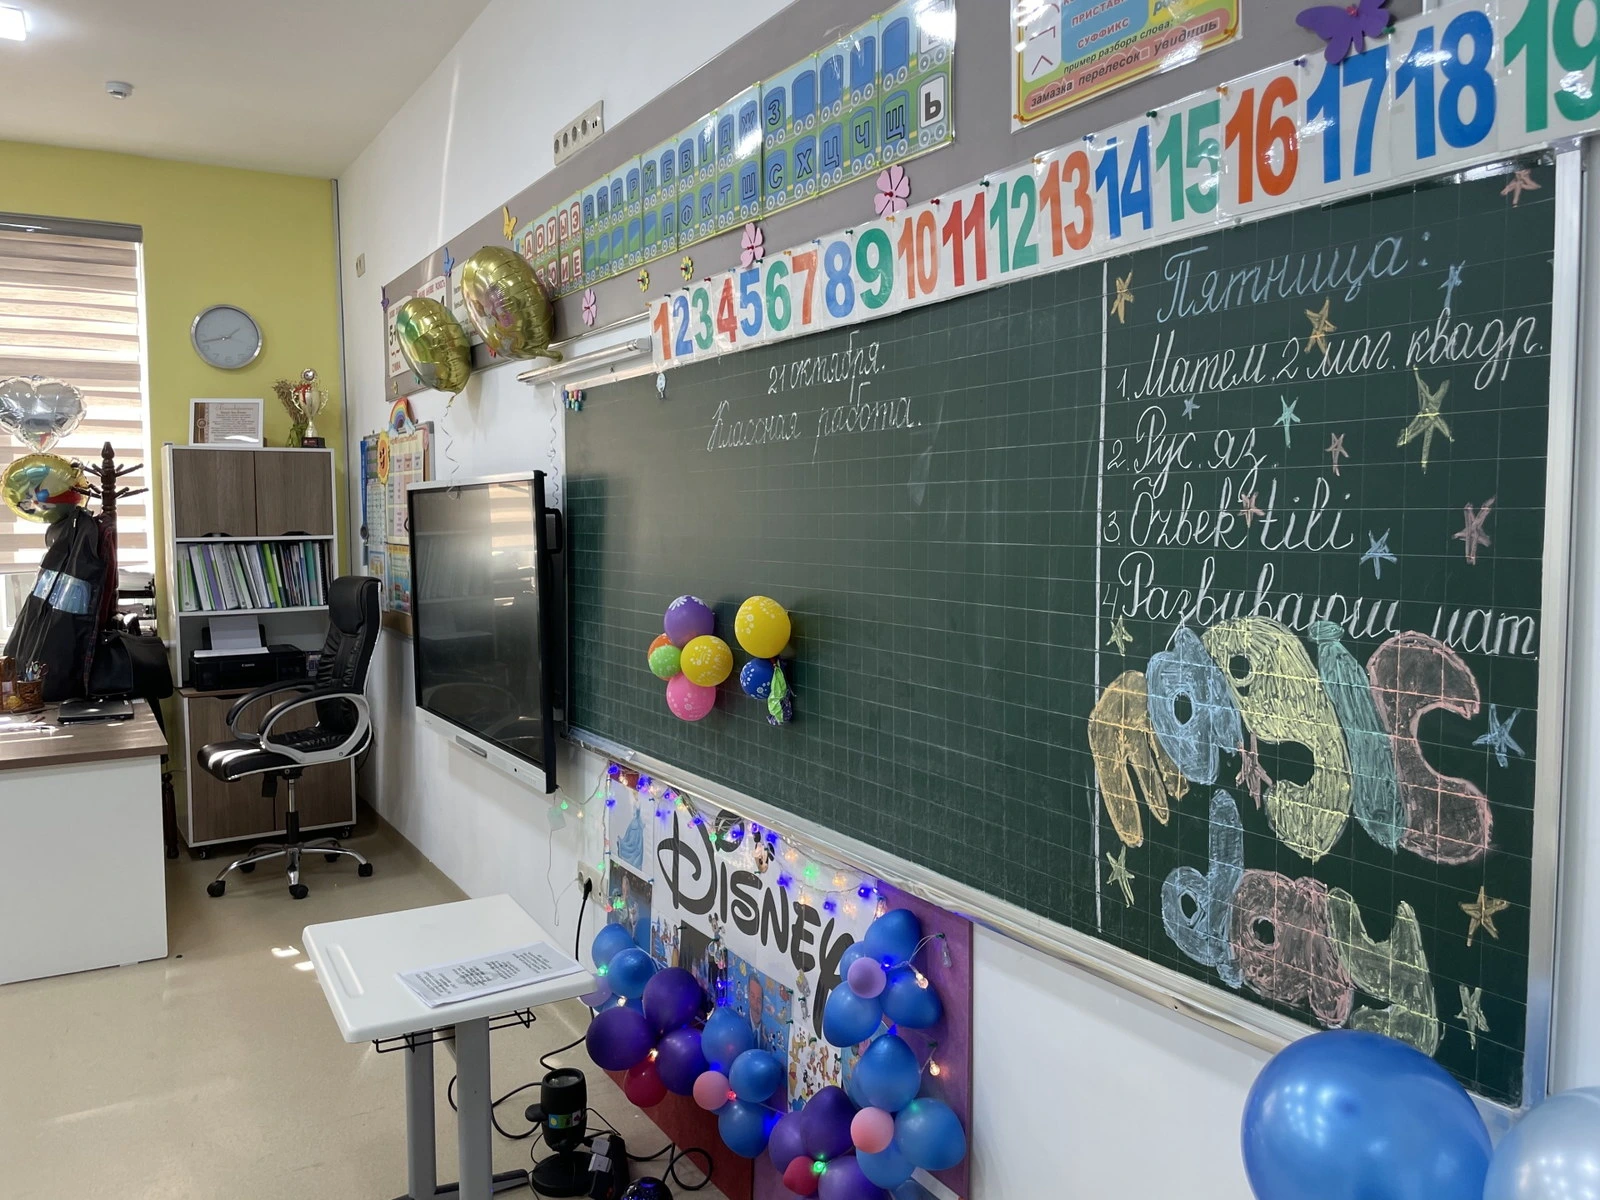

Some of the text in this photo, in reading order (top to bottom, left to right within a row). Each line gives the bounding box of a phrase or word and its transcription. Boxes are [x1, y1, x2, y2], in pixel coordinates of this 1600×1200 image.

[1063, 18, 1174, 74] пример разбора слова:
[1072, 0, 1125, 26] ПРИСТАВ
[1077, 18, 1129, 49] СУФФИКС
[1031, 21, 1217, 107] замазка перелесок увидишь
[526, 239, 532, 257] А
[537, 232, 543, 249] О
[549, 223, 555, 243] У
[572, 210, 579, 230] Э
[585, 202, 593, 224] Н
[629, 177, 637, 200] Р
[663, 158, 672, 183] Б
[681, 149, 691, 174] В
[720, 122, 731, 155] Д
[768, 99, 781, 126] З
[574, 255, 580, 275] Е
[663, 212, 673, 236] П
[681, 204, 692, 227] Ф
[702, 192, 712, 218] К
[721, 183, 731, 208] Т
[742, 172, 756, 200] Ш
[768, 163, 782, 189] С
[796, 148, 812, 179] Х
[824, 135, 840, 168] Ц
[854, 119, 870, 148] Ч
[886, 104, 905, 140] Щ
[653, 0, 1600, 361] 1 2 3 4 5 6 7 8 9 10 11 12 13 14 15 16 17 18 19
[767, 330, 886, 403] 21 октября.
[1405, 307, 1543, 390] квадр.
[706, 381, 922, 464] Классная работа.
[1107, 438, 1130, 472] 2.
[1133, 405, 1202, 499] Рус.
[1258, 477, 1354, 551] tili
[1161, 789, 1440, 1057] day
